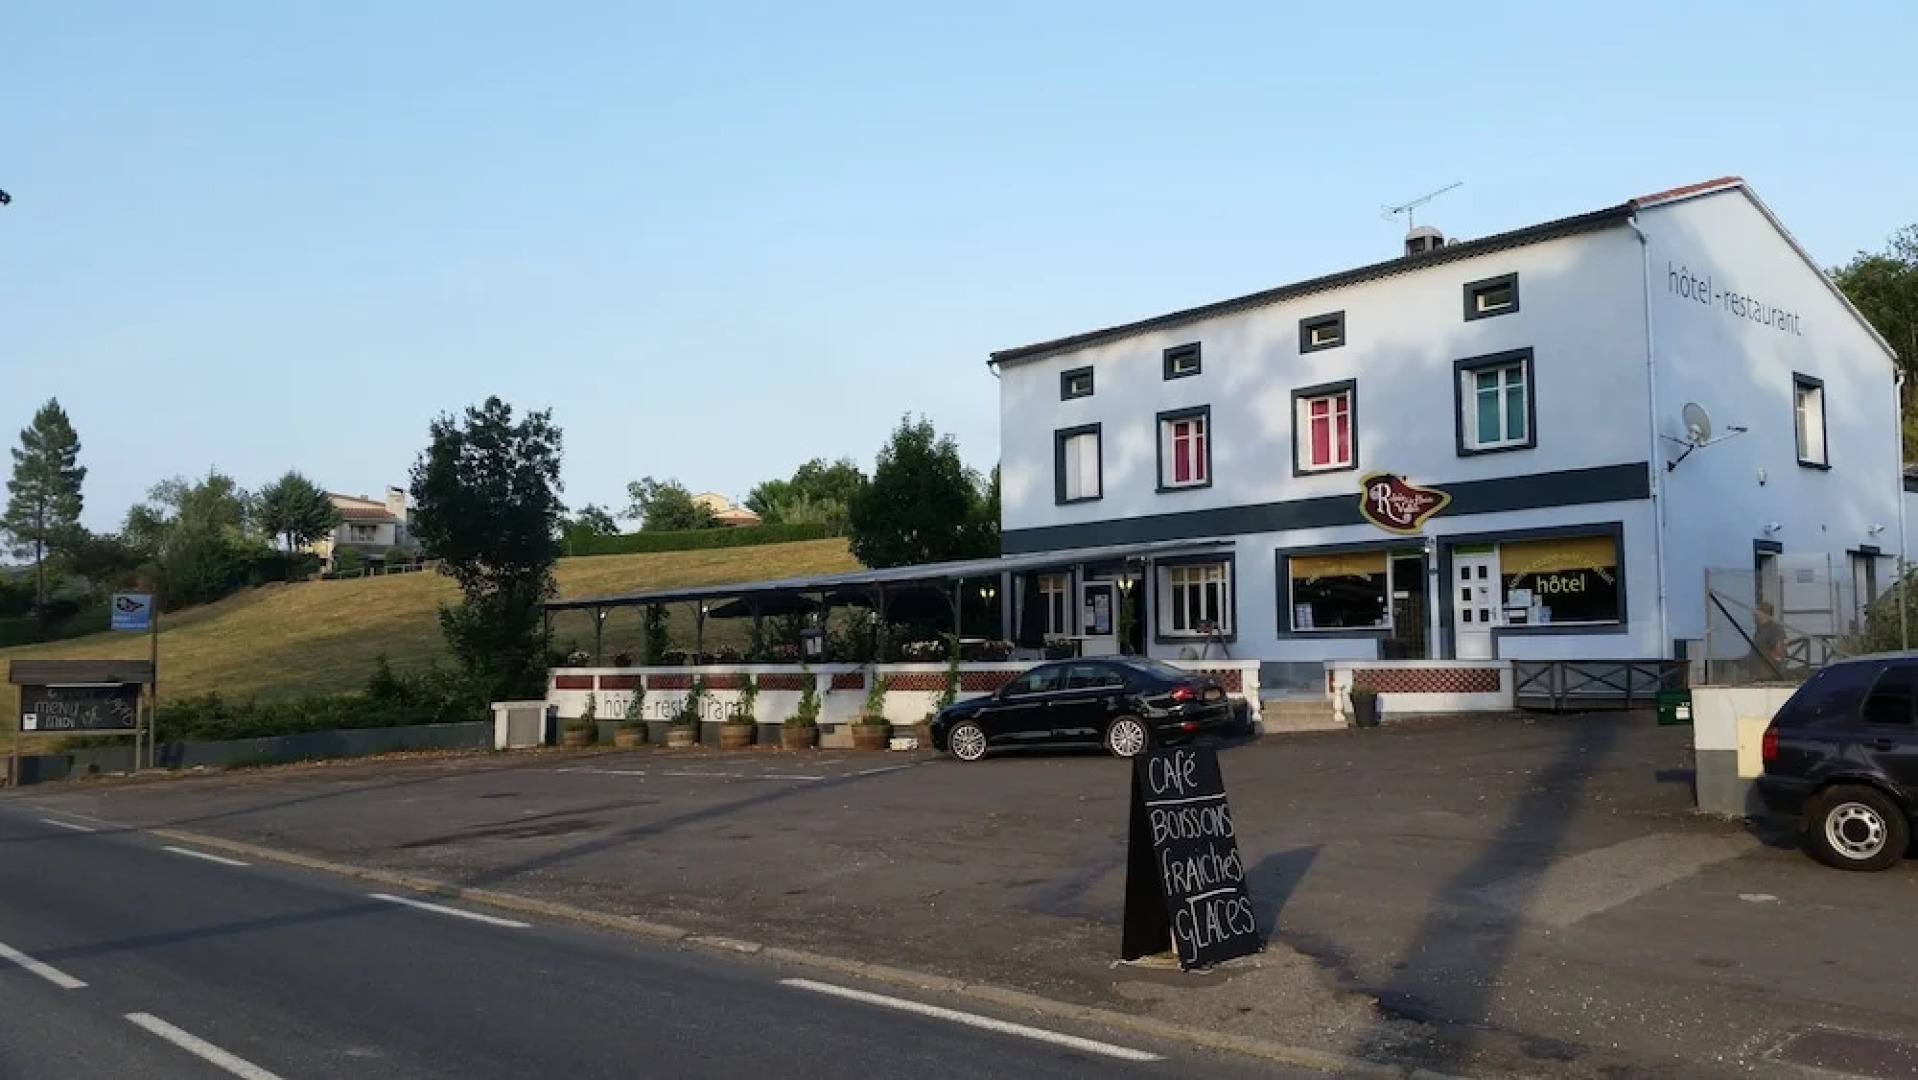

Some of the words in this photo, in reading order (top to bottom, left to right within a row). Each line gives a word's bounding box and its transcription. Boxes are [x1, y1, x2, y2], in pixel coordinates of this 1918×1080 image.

[1723, 291, 1802, 336] restaurant
[1536, 572, 1585, 594] hôtel
[1150, 803, 1235, 847] BOISSONS
